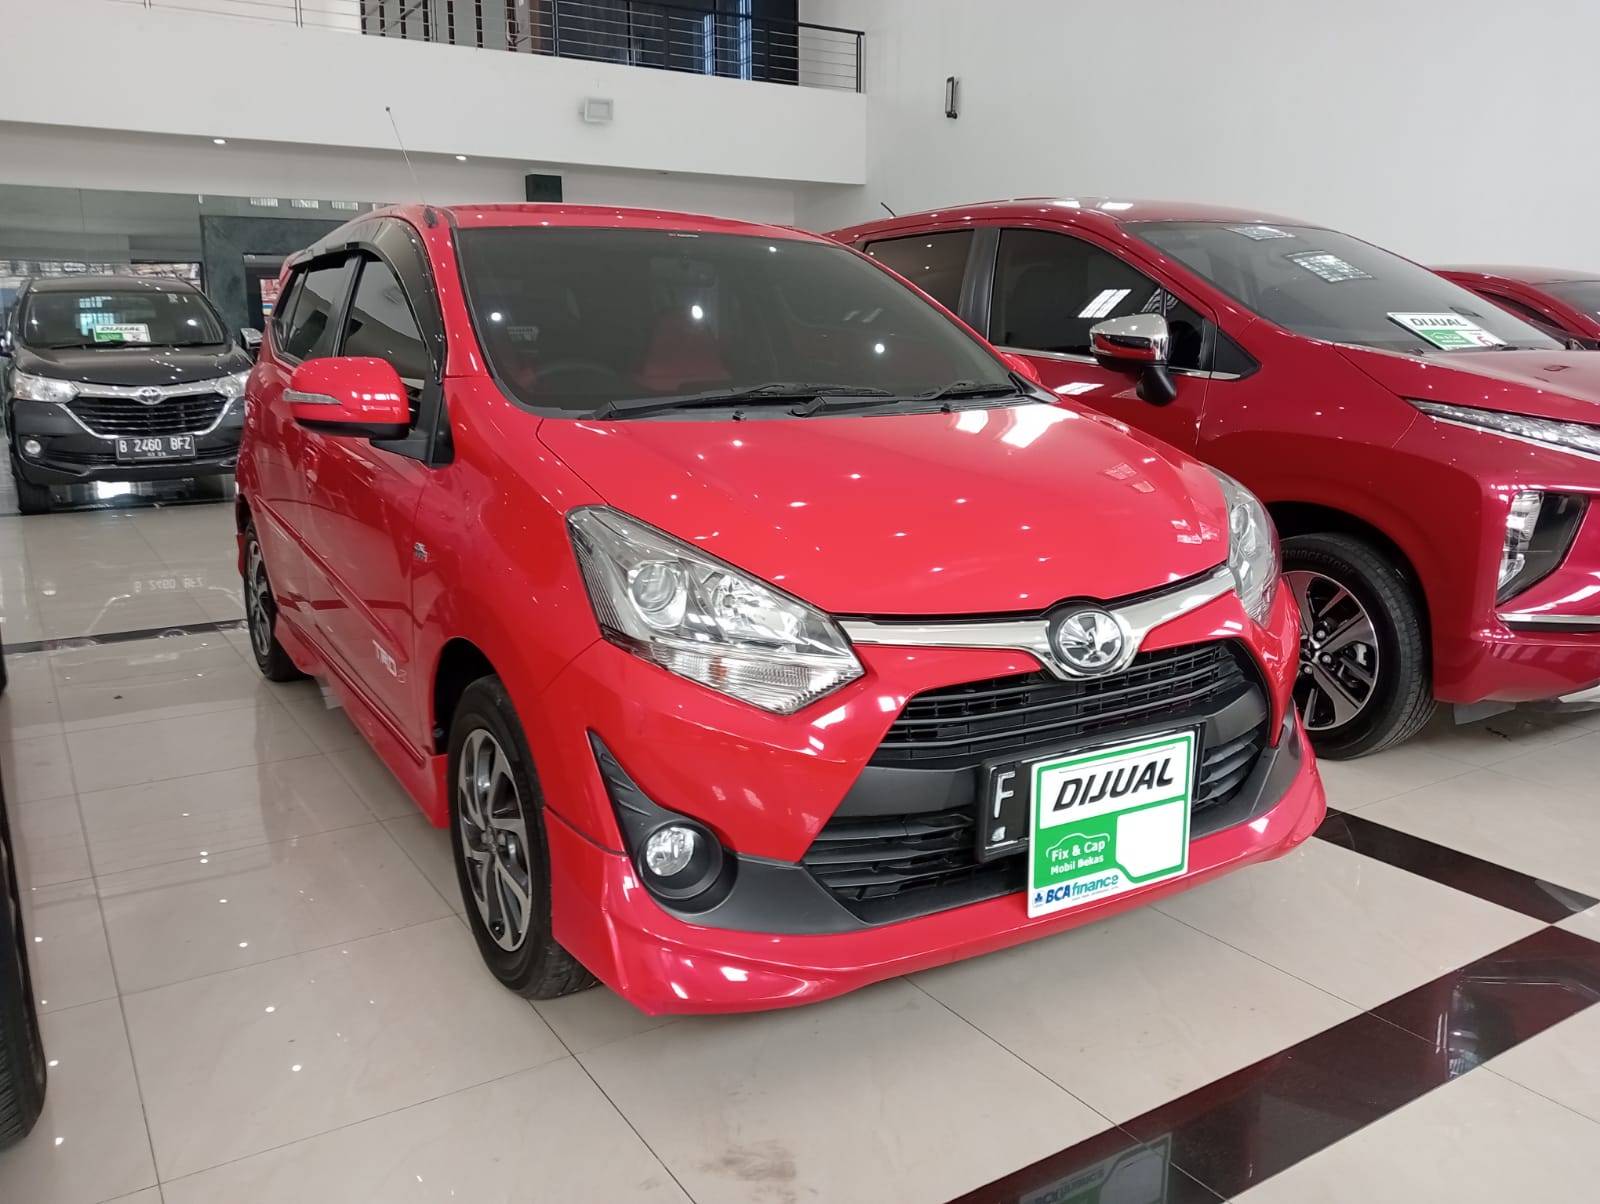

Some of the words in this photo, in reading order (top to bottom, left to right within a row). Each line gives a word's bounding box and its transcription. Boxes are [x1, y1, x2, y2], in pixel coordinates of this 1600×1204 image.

[1410, 318, 1468, 327] DIJUAL
[119, 440, 128, 453] B
[133, 438, 162, 452] 2460
[169, 437, 191, 450] BFZ
[994, 770, 1016, 819] F
[1052, 758, 1174, 812] DIJUAL
[1051, 849, 1069, 862] Fix
[1071, 844, 1081, 857] &
[1083, 840, 1106, 853] Cap
[1050, 861, 1076, 875] Mobil
[1077, 855, 1104, 868] Bekas
